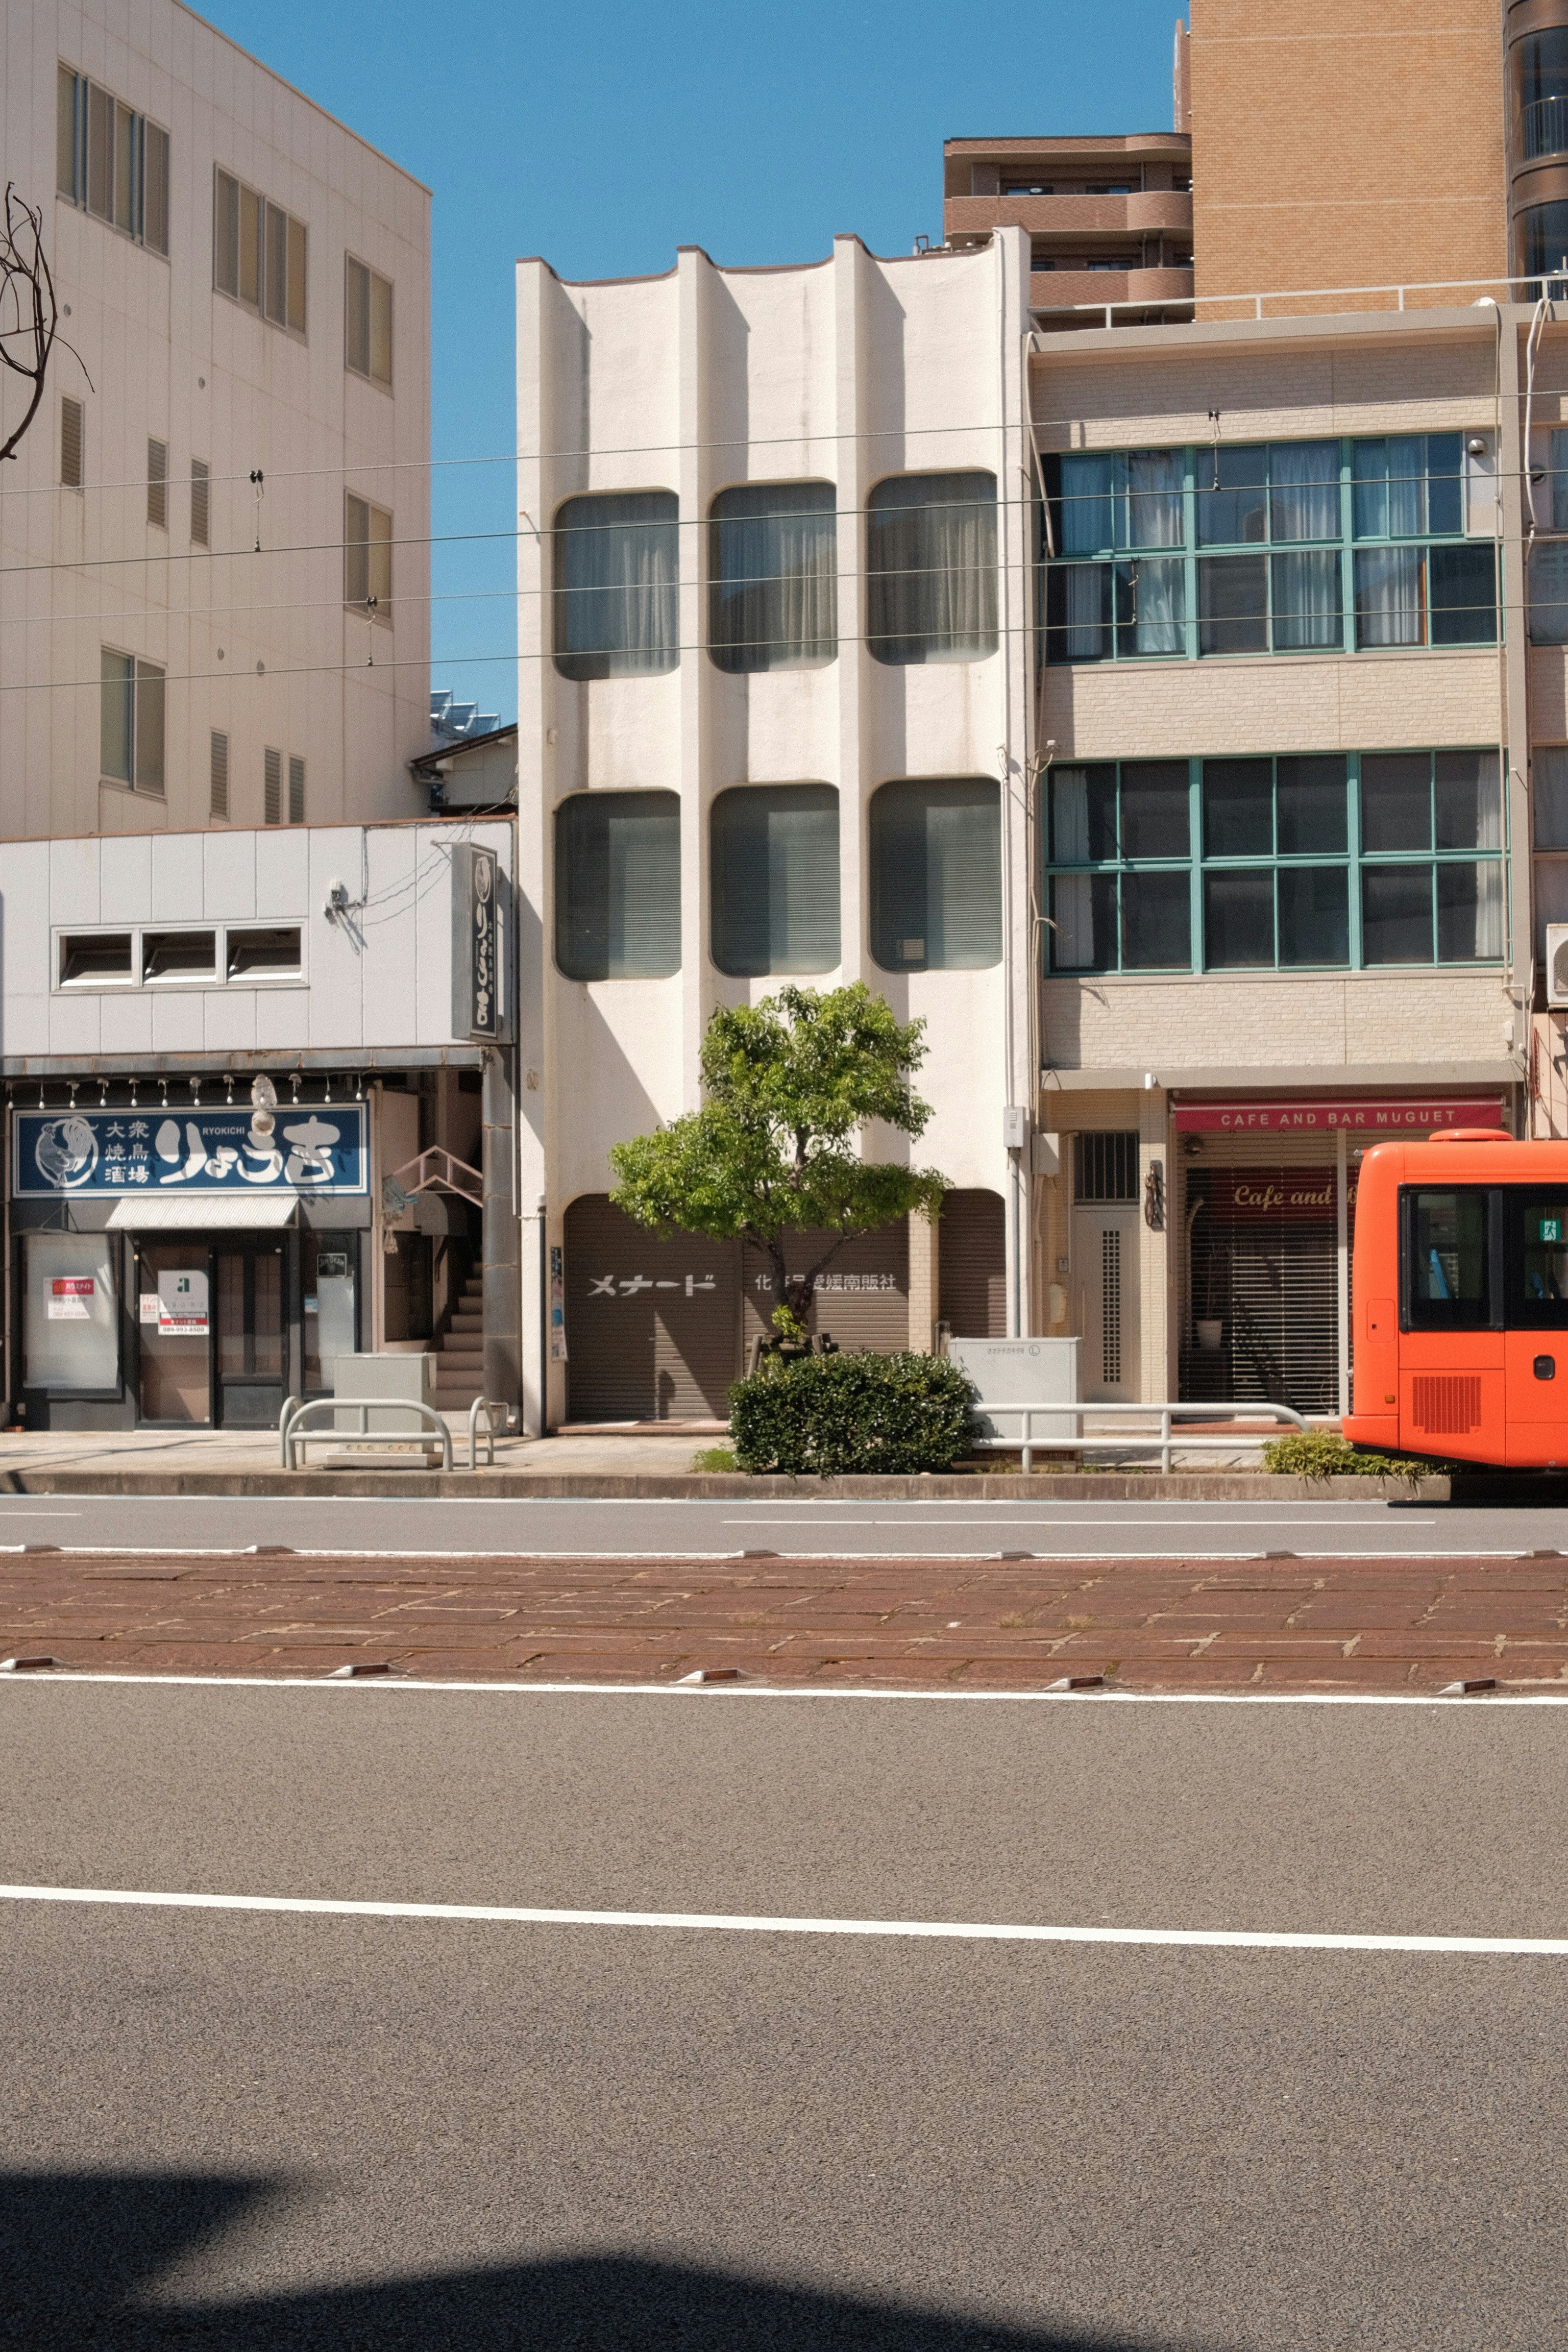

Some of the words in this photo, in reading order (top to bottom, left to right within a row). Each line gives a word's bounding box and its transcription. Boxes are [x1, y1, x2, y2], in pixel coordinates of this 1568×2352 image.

[1221, 1114, 1269, 1126] CAFE
[1280, 1113, 1316, 1125] AND
[1328, 1112, 1365, 1124] BAR
[1377, 1110, 1455, 1123] MUGUET
[105, 1120, 150, 1138] 大衆
[203, 1126, 245, 1136] RYOKICHI
[105, 1143, 149, 1161] 焼鳥
[155, 1115, 340, 1184] りょう吉
[105, 1166, 150, 1183] 酒場
[1234, 1185, 1285, 1211] Cafe
[1290, 1184, 1332, 1205] and
[587, 1275, 716, 1296] メナード
[755, 1274, 896, 1290] 化愛媛南販社
